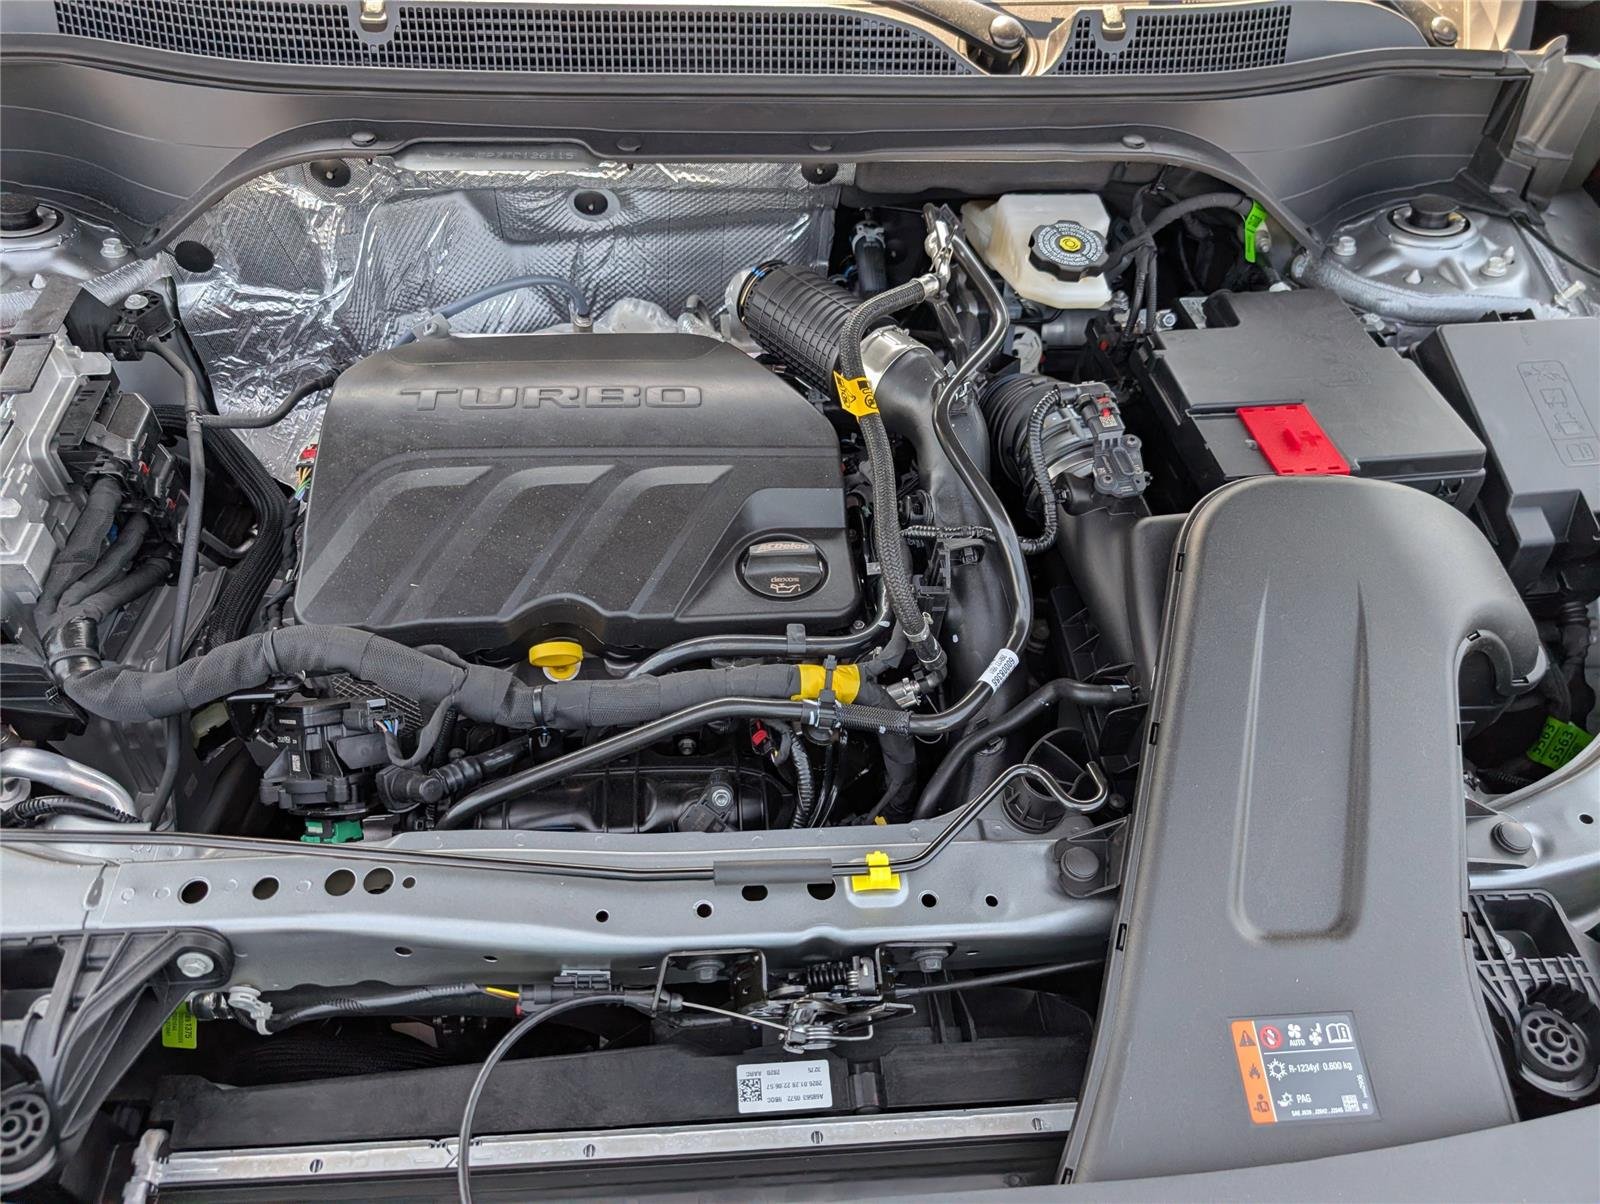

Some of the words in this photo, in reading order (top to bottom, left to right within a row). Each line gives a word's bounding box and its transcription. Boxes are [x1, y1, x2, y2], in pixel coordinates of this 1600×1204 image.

[400, 385, 703, 412] TURBO
[1549, 730, 1574, 764] 5563
[1289, 1038, 1306, 1047] AUTO
[1288, 1062, 1320, 1073] R-1234yf
[1322, 1061, 1342, 1071] 0.600
[1342, 1061, 1353, 1071] kg
[1296, 1093, 1313, 1104] PAG
